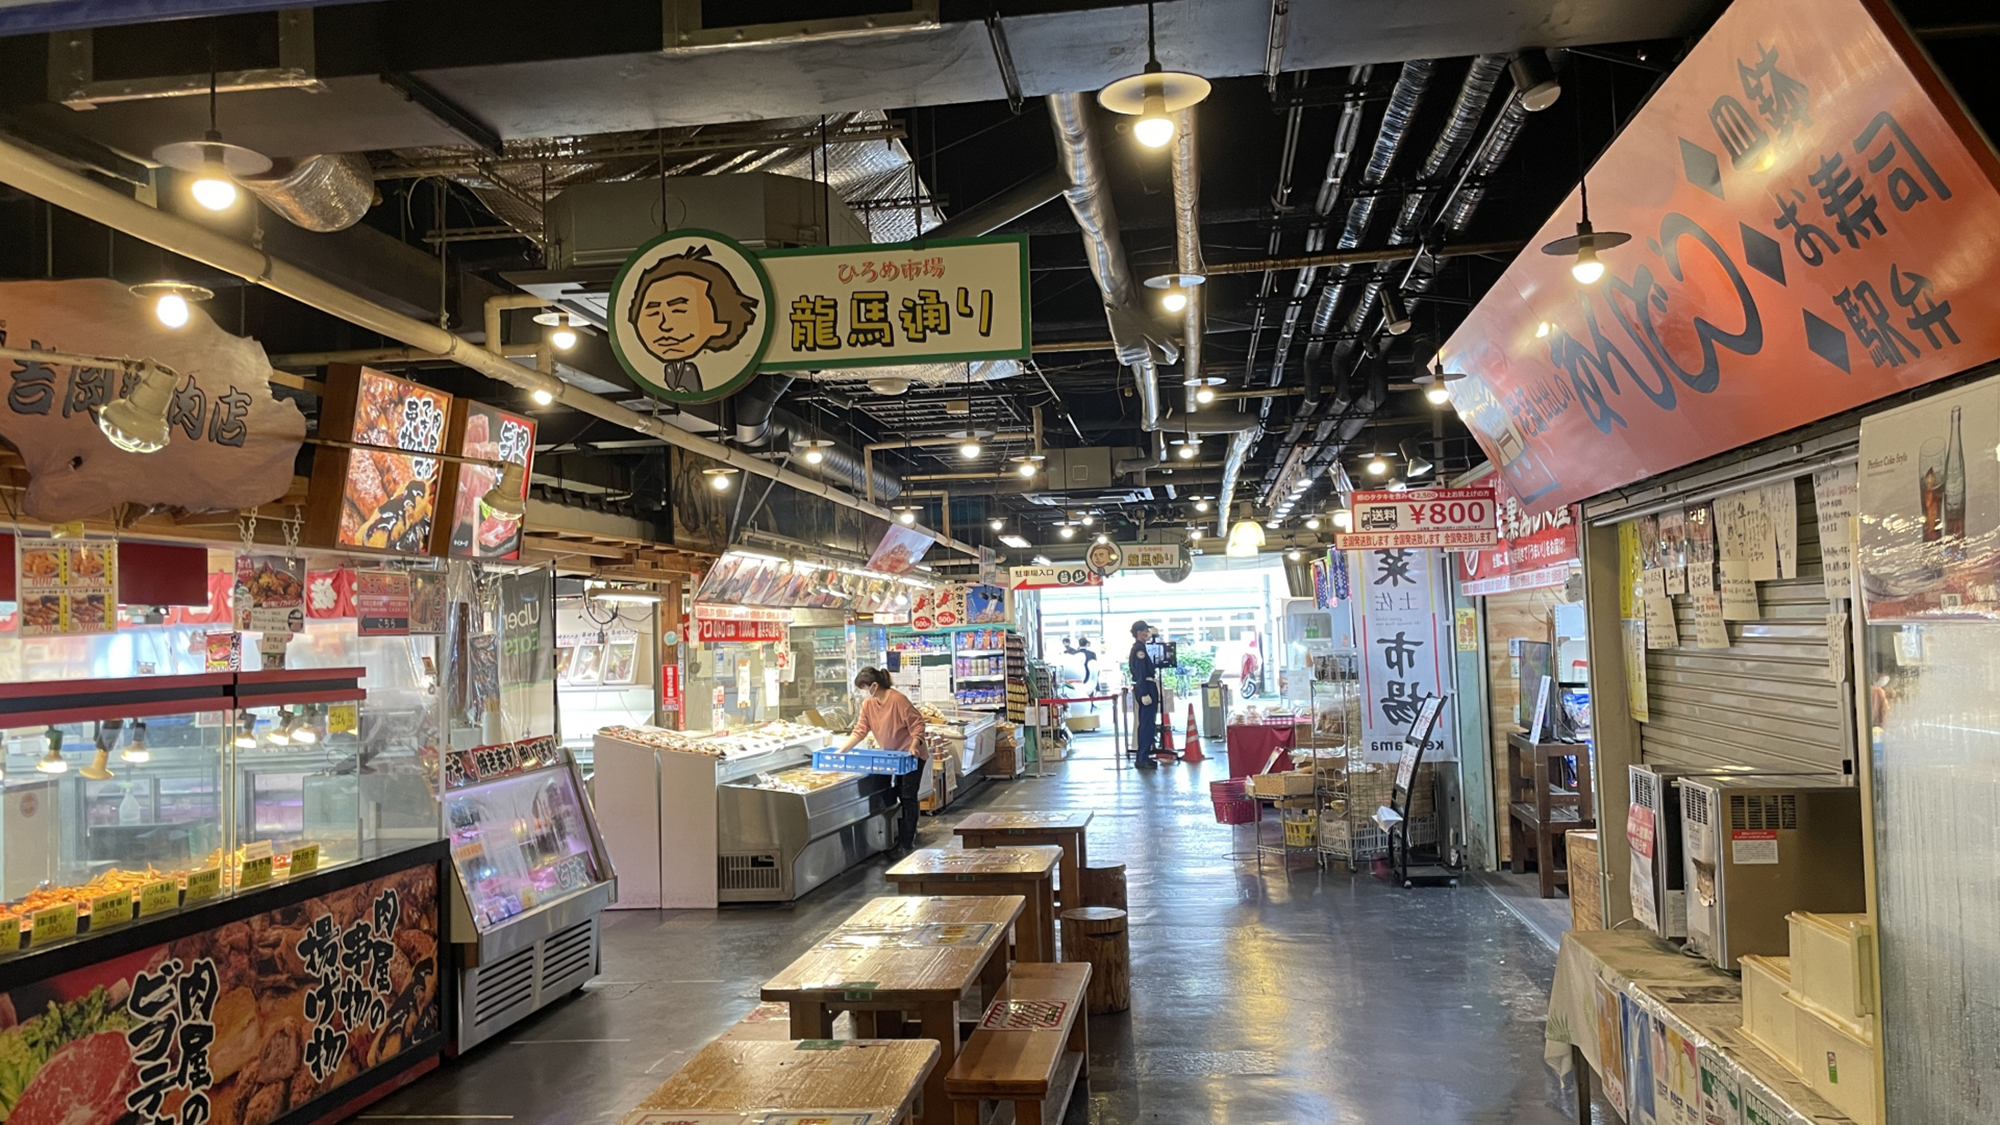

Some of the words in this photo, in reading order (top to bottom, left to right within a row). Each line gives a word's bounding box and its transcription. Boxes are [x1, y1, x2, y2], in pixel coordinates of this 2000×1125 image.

[1773, 111, 1953, 267] お寿司
[838, 257, 945, 284] ひろめ市場
[789, 286, 994, 352] 龍馬通り
[1832, 262, 1961, 368] 駅弁
[1884, 455, 1896, 466] Coke
[1896, 452, 1908, 465] Style
[1342, 535, 1389, 548] 全国発送致します
[1393, 533, 1440, 546] 全国発送致します
[1444, 531, 1492, 544] 全国発送致します
[1371, 508, 1397, 521] 送料
[1408, 502, 1485, 525] ¥800
[1015, 569, 1054, 578] 駐車場入口
[1127, 552, 1174, 567] 龍馬通り
[377, 618, 396, 629] こちら
[338, 920, 374, 1033] 串物
[368, 886, 401, 1035] 肉屋の
[296, 912, 349, 1084] 揚げ物
[126, 957, 184, 1125] ビフテ
[176, 957, 220, 1125] 肉屋の
